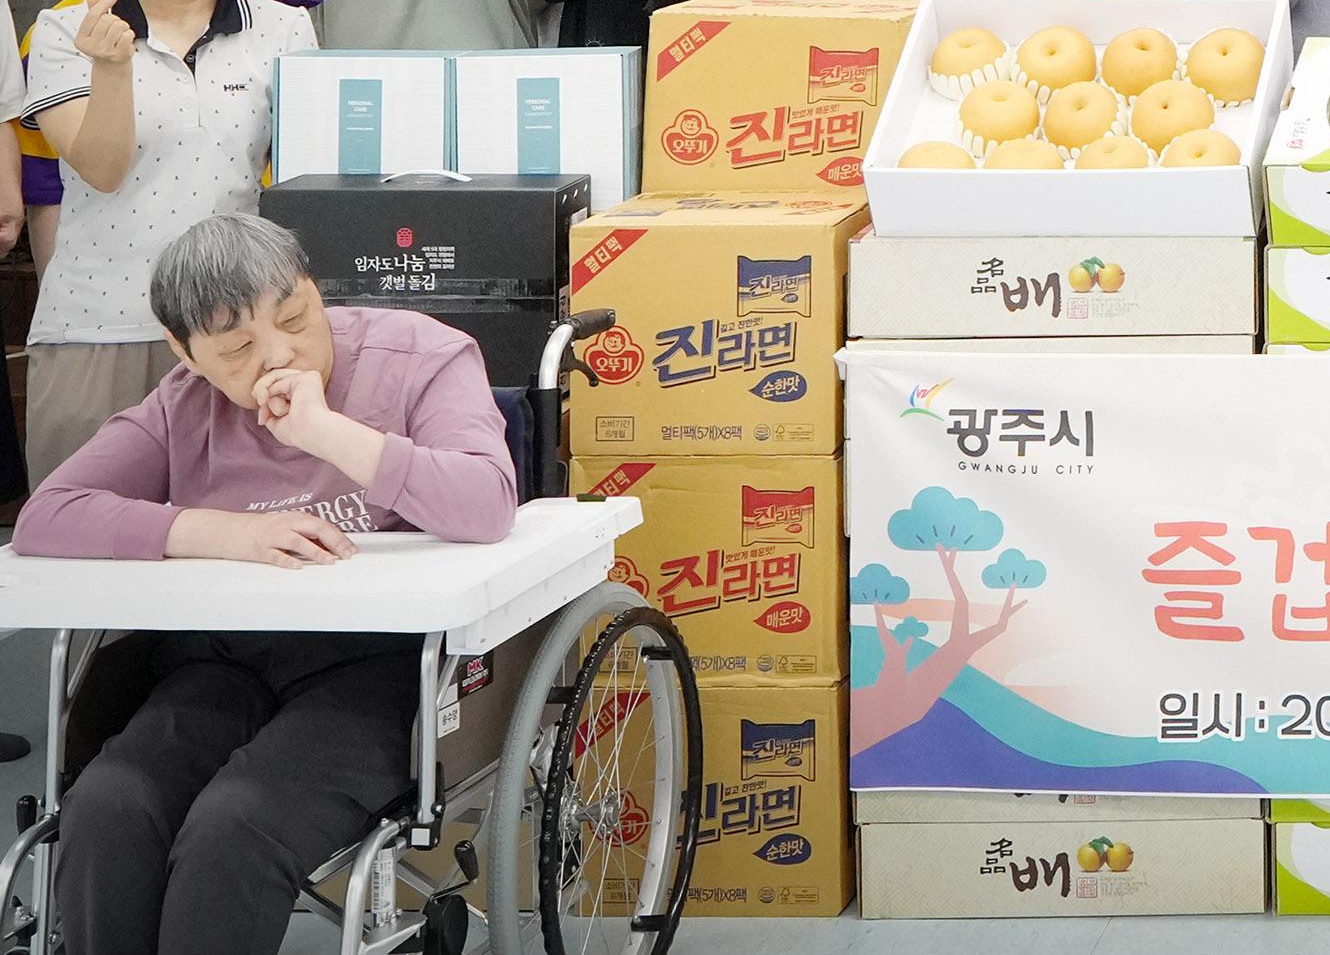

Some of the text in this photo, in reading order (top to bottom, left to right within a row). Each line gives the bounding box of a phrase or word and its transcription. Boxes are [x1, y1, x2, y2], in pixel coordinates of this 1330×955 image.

[668, 28, 707, 63] 멀티팩
[672, 138, 708, 155] 오뚜기
[725, 106, 864, 169] 진라면
[583, 236, 623, 274] 멀티팩
[749, 275, 800, 298] 진라면
[1000, 272, 1061, 318] 배
[594, 356, 634, 373] 오뚜기
[652, 318, 797, 388] 진라면
[761, 374, 801, 398] 순한맛
[945, 407, 1096, 459] 광주시
[957, 461, 1096, 475] GWANGJU CITY
[246, 492, 313, 511] MY LIFE IS
[656, 548, 800, 619] 진라면
[765, 607, 805, 629] 매운맛
[766, 838, 805, 861] 순한맛
[1009, 852, 1071, 897] 배
